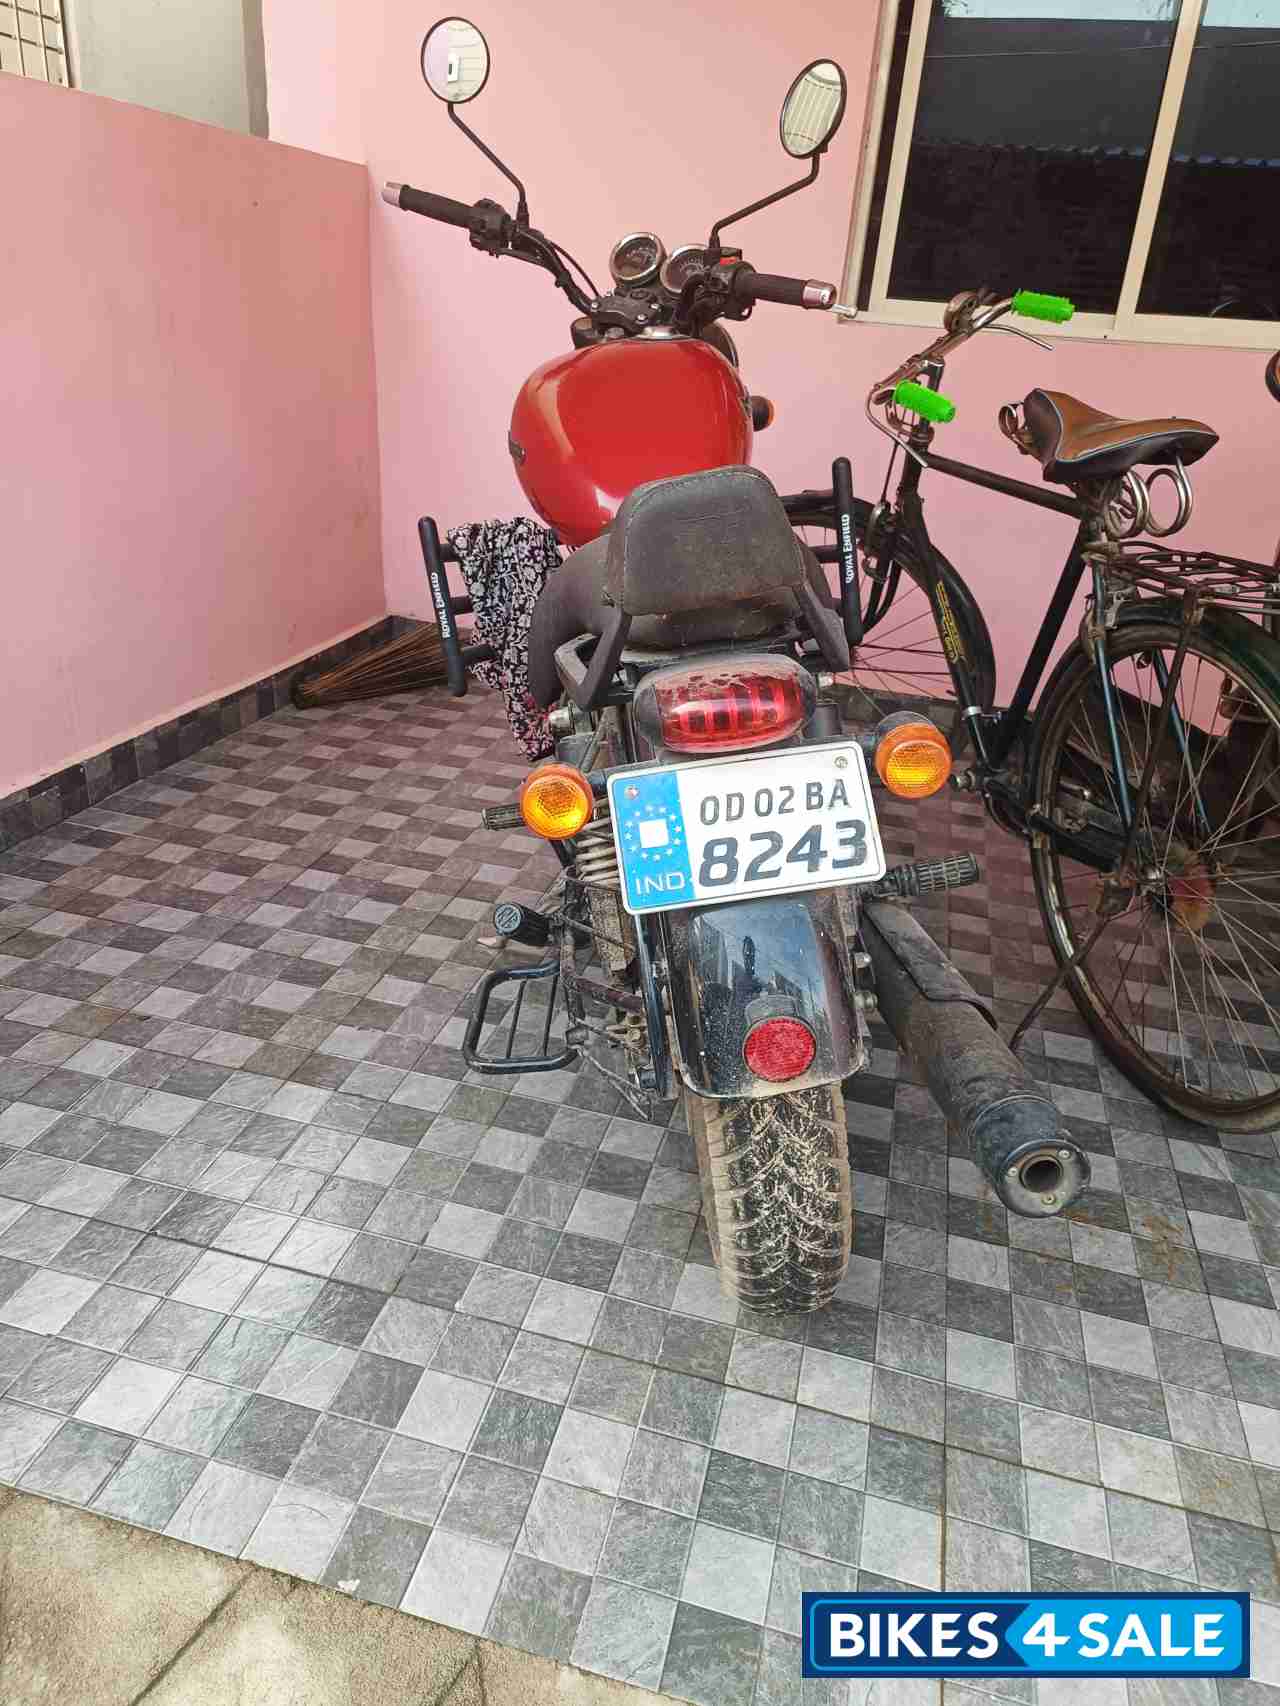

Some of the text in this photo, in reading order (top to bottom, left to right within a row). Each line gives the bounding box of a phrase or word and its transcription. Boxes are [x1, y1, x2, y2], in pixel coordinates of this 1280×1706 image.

[845, 554, 855, 583] ROYAL
[439, 608, 450, 638] ROYAL
[700, 778, 851, 826] OD 02 BA
[699, 819, 868, 888] 8243
[635, 871, 686, 896] IND
